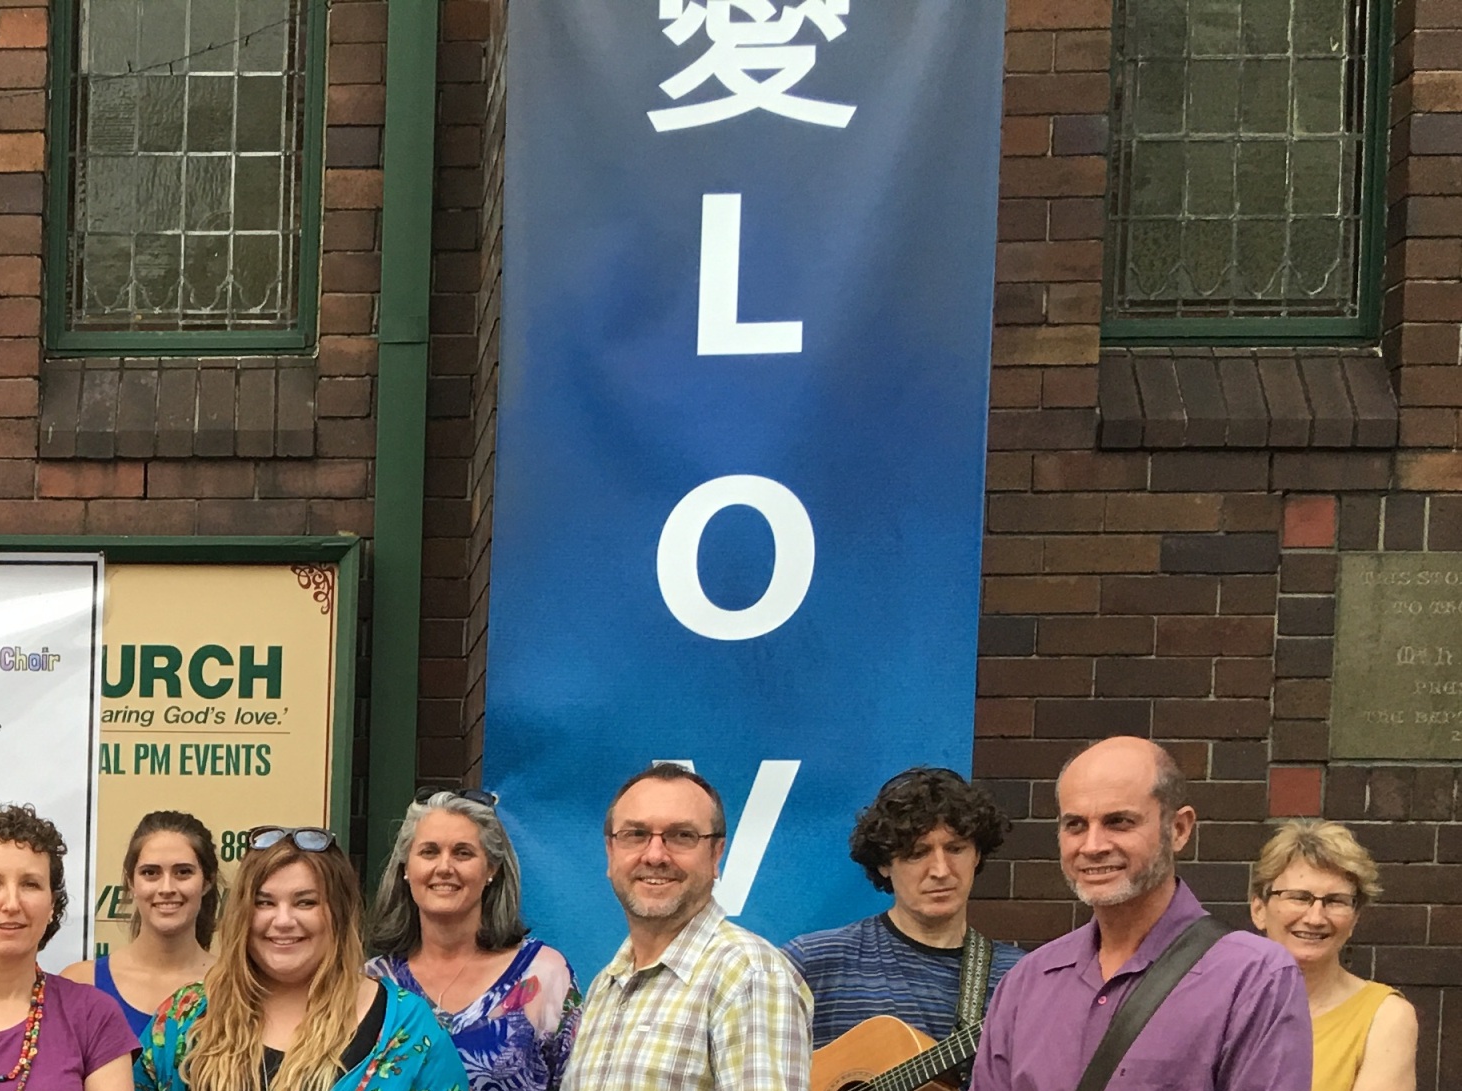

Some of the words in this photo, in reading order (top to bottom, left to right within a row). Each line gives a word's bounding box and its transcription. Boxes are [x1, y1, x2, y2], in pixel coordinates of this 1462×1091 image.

[0, 646, 61, 672] Choir
[101, 705, 155, 727] aring
[163, 705, 226, 725] God's
[134, 743, 171, 776] PM
[179, 744, 271, 777] EVENTS
